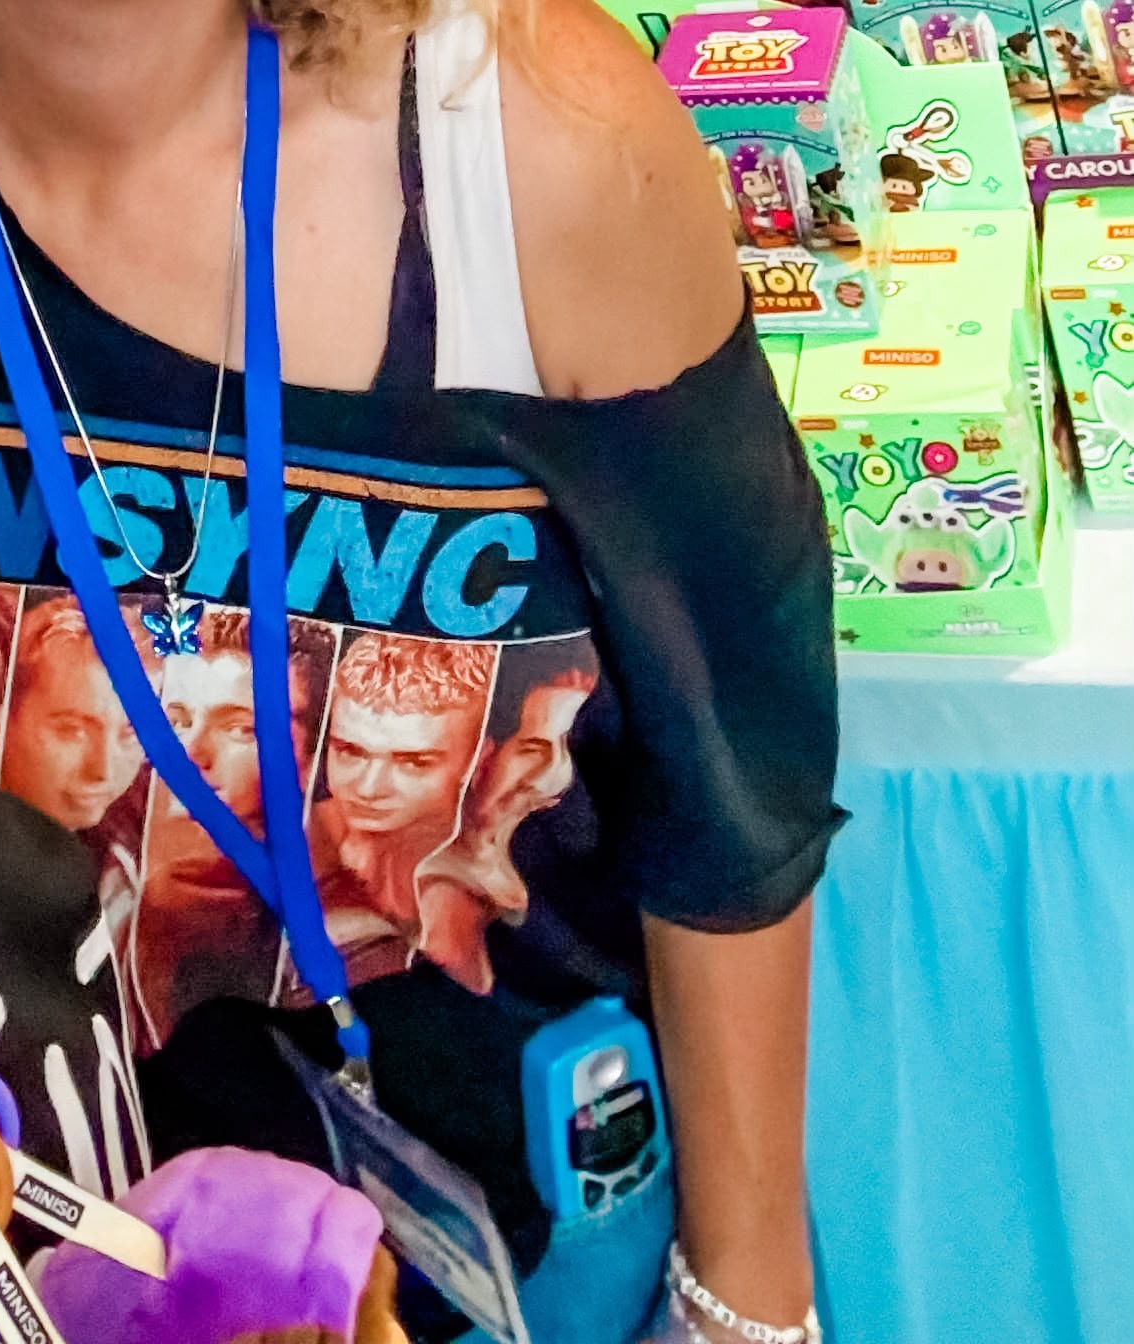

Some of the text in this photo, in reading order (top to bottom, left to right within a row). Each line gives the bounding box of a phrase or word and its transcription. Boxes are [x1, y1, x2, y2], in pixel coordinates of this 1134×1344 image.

[702, 38, 800, 62] TOY
[706, 60, 782, 72] STORY
[1045, 158, 1134, 180] CAROU
[740, 261, 819, 295] TOY
[751, 294, 813, 308] STORY
[868, 350, 935, 364] MINISO
[817, 437, 959, 491] YOYO
[20, 1176, 83, 1226] MINISO
